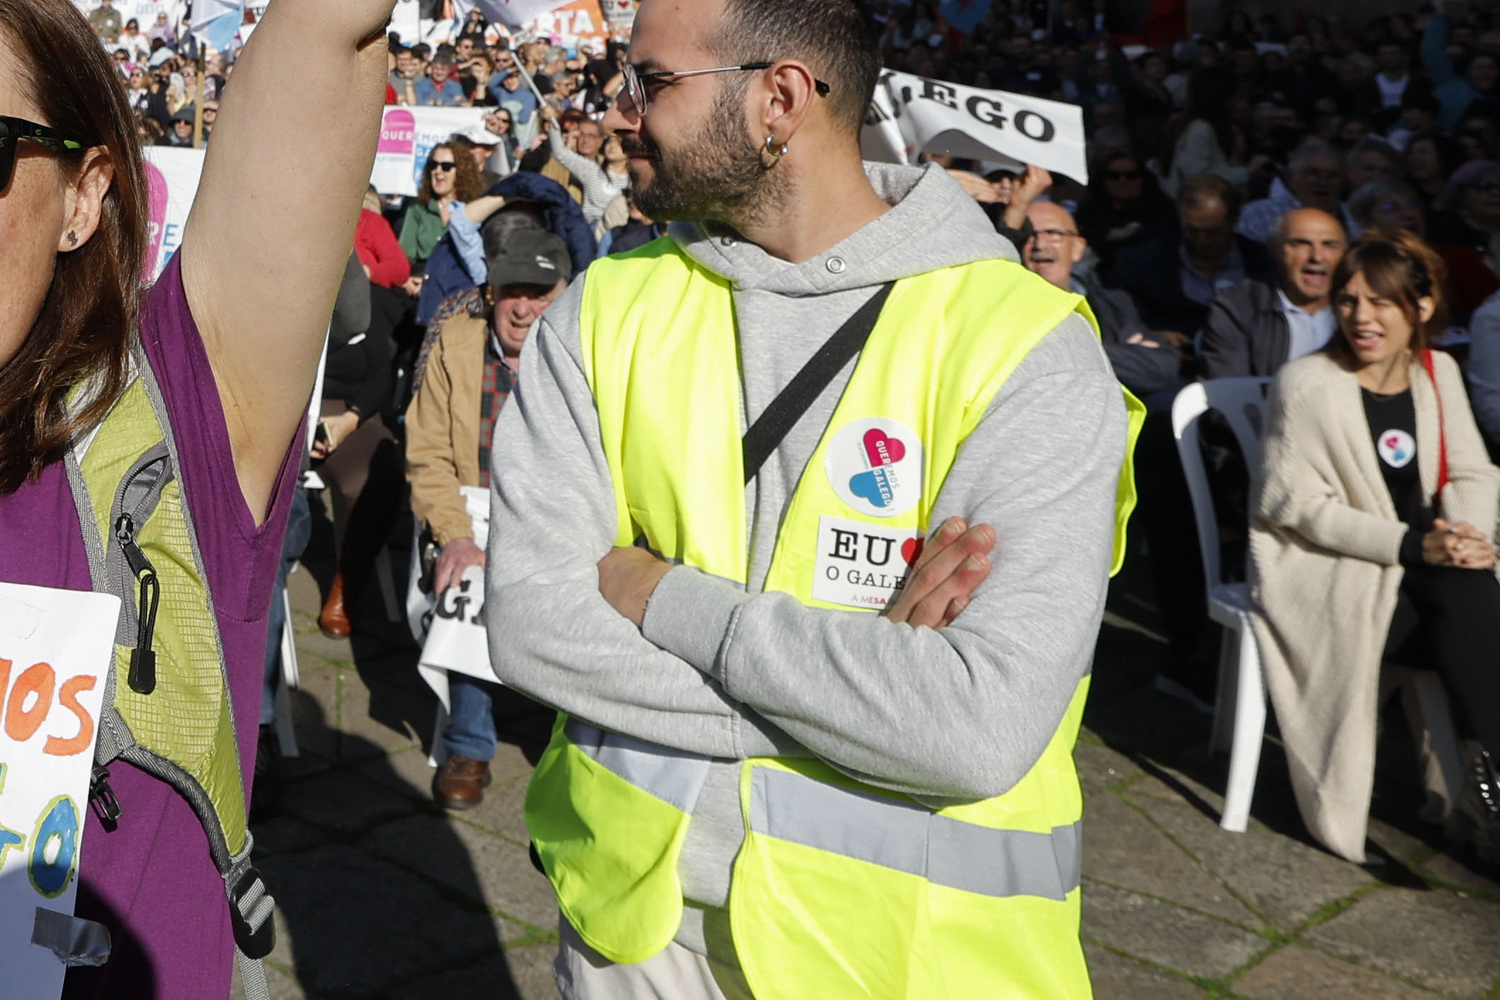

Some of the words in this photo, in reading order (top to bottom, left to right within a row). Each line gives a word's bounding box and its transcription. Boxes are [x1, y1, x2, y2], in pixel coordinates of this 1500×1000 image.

[876, 71, 1056, 143] LEGO
[875, 440, 900, 489] QUEREMOS
[828, 527, 897, 567] EU
[825, 566, 840, 581] O
[860, 595, 887, 605] MESA
